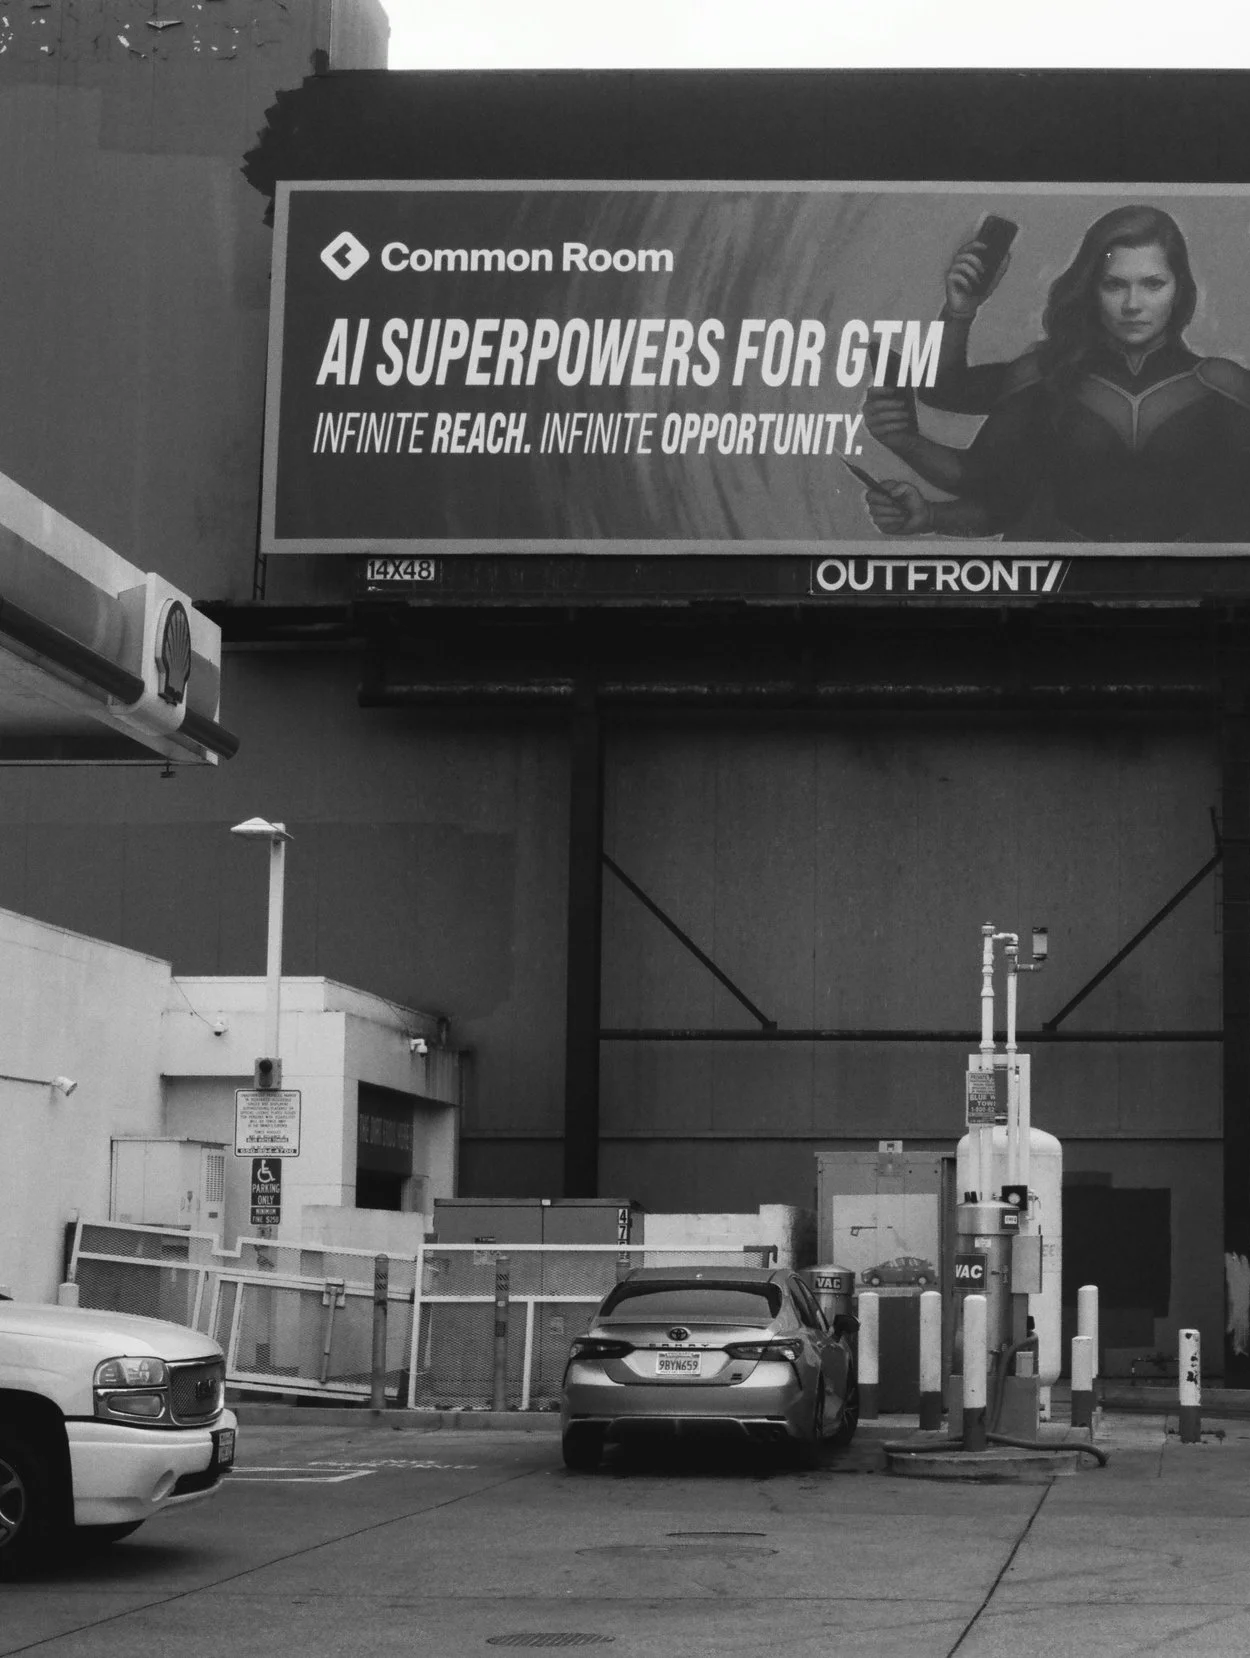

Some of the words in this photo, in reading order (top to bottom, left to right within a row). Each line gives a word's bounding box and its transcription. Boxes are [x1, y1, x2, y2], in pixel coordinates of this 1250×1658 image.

[381, 242, 553, 273] Common
[562, 242, 674, 273] Room
[316, 318, 370, 387] AI
[376, 318, 724, 387] SUPERPOWERS
[732, 318, 829, 388] FOR
[836, 320, 944, 388] GTM
[313, 412, 429, 454] INFINITE
[432, 412, 531, 454] REACH.
[540, 412, 657, 454] INFINITE
[661, 412, 863, 455] OPPORTUNITY.
[368, 560, 432, 579] 14X48
[252, 1183, 280, 1194] PARKING
[257, 1195, 275, 1205] ONLY
[955, 1264, 983, 1280] VAC
[816, 1277, 841, 1289] VAC
[658, 1360, 699, 1371] 9BYN659
